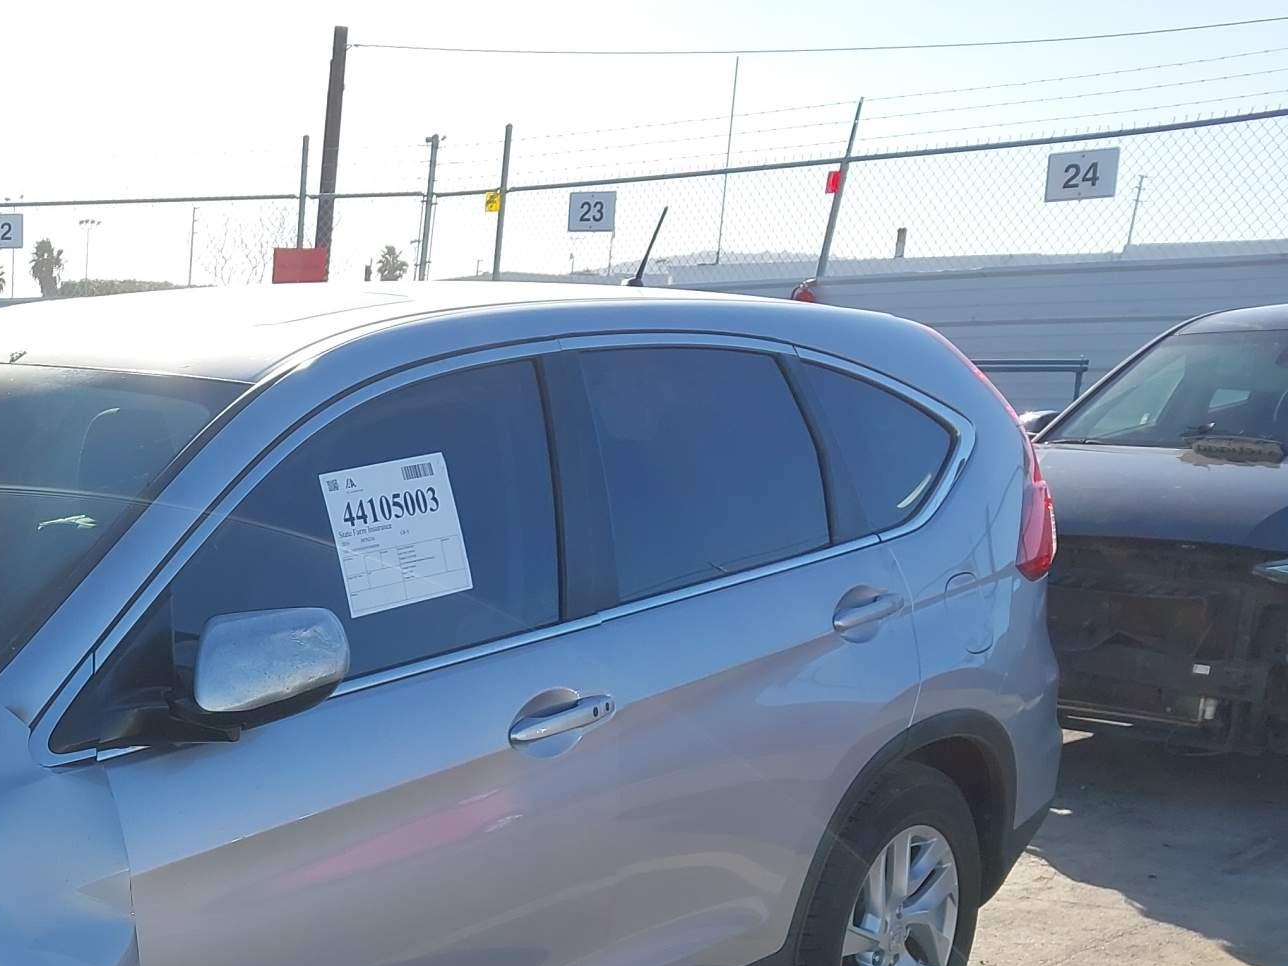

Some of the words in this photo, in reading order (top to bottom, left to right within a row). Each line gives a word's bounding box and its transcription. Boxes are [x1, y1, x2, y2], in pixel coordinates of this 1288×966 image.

[1062, 162, 1100, 189] 24
[579, 201, 604, 222] 23
[343, 486, 440, 527] 44105003
